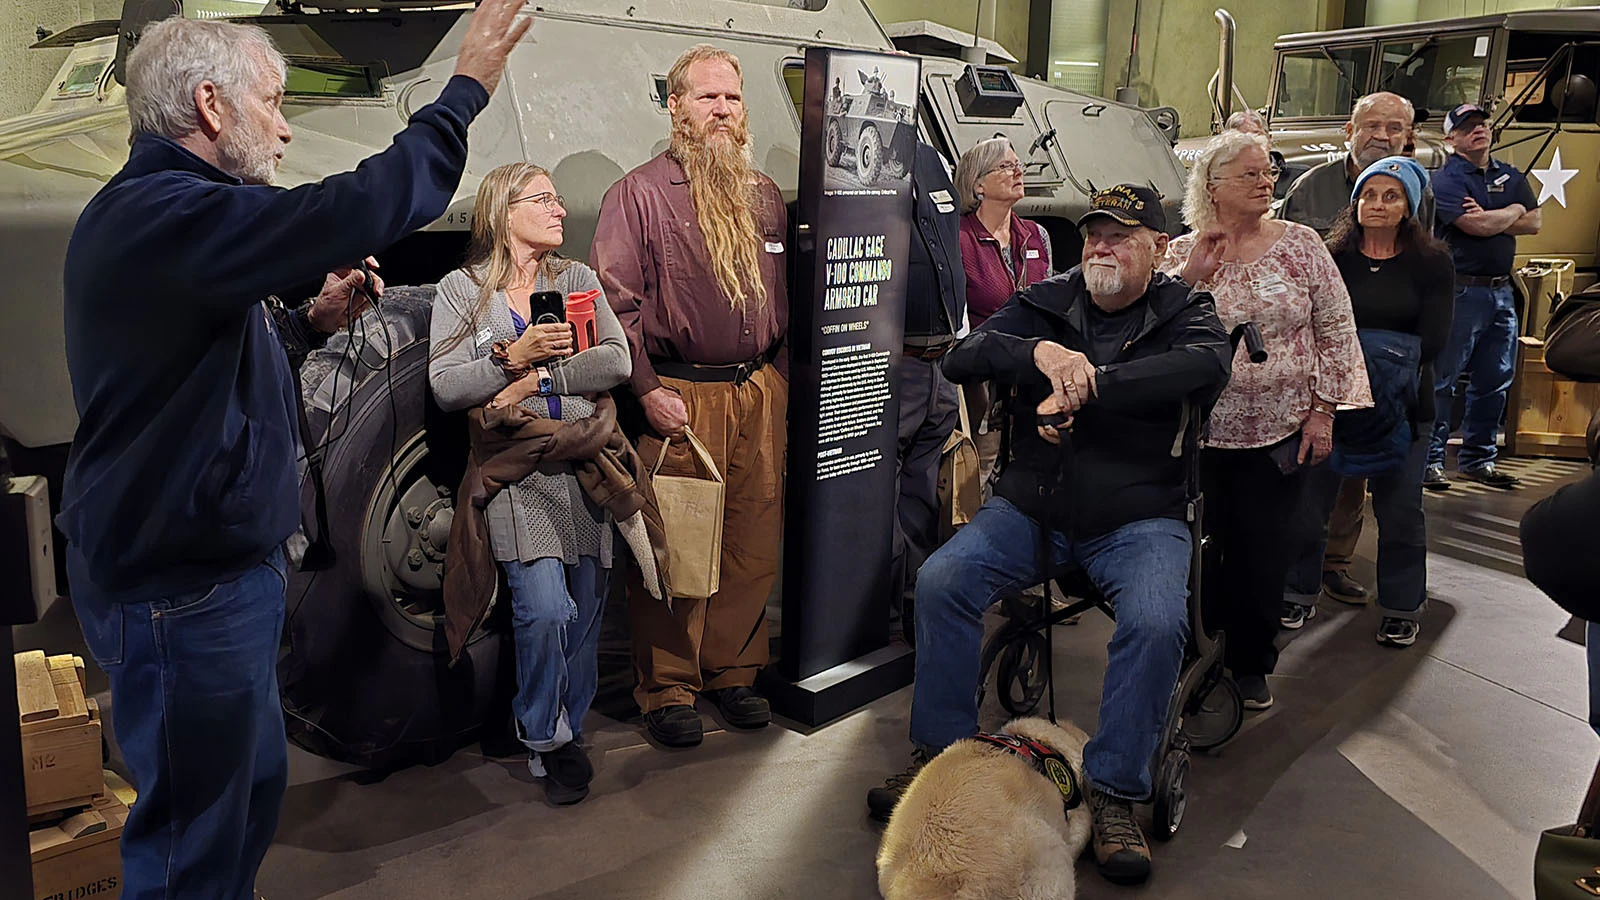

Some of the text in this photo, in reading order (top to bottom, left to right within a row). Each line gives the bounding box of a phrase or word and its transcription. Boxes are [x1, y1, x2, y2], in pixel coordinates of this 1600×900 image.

[1092, 198, 1132, 210] ETERAN
[827, 235, 885, 260] CADILLAC GAGE
[826, 259, 892, 286] V-100 COMMANDO
[824, 284, 879, 311] ARMORED CAR
[841, 323, 848, 333] ON
